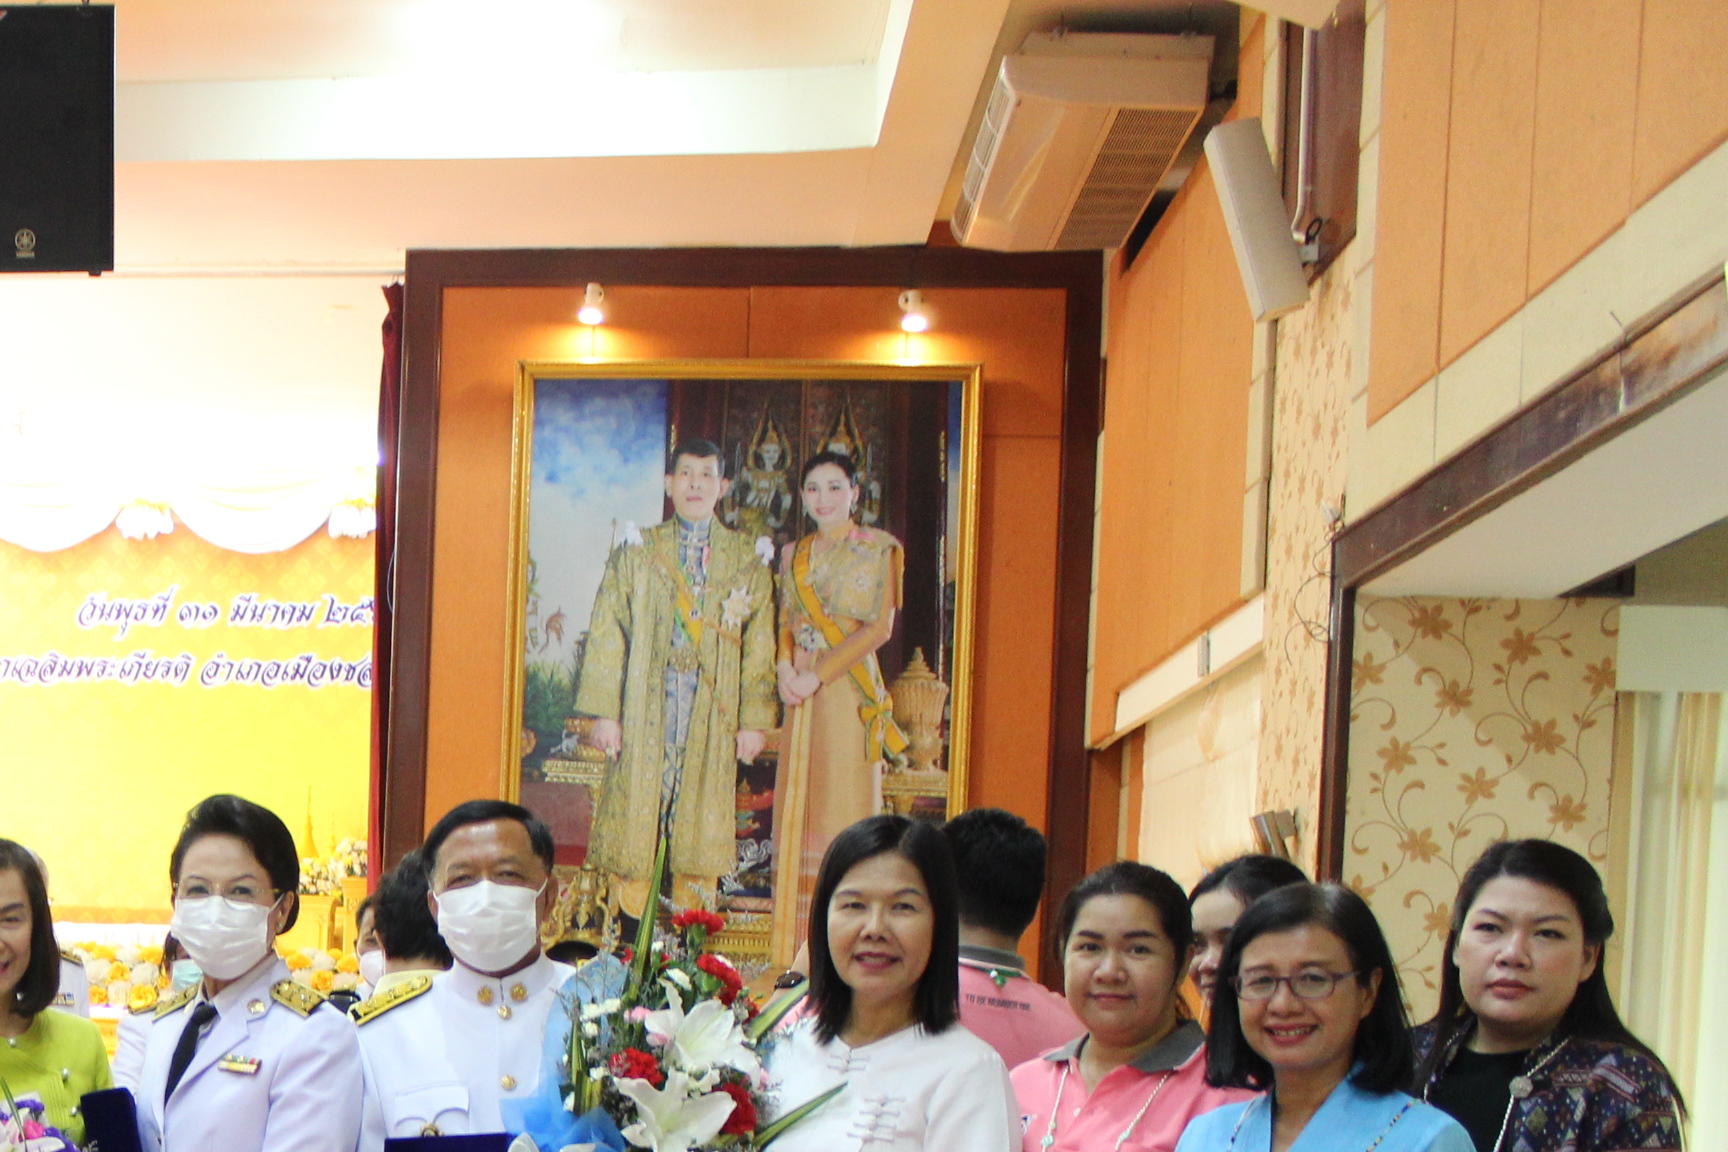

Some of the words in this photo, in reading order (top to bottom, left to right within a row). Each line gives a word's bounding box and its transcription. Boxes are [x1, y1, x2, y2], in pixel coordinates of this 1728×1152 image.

[77, 586, 174, 636] วันพุธที่
[229, 594, 315, 625] มีนาคม
[323, 594, 374, 625] ๒๕
